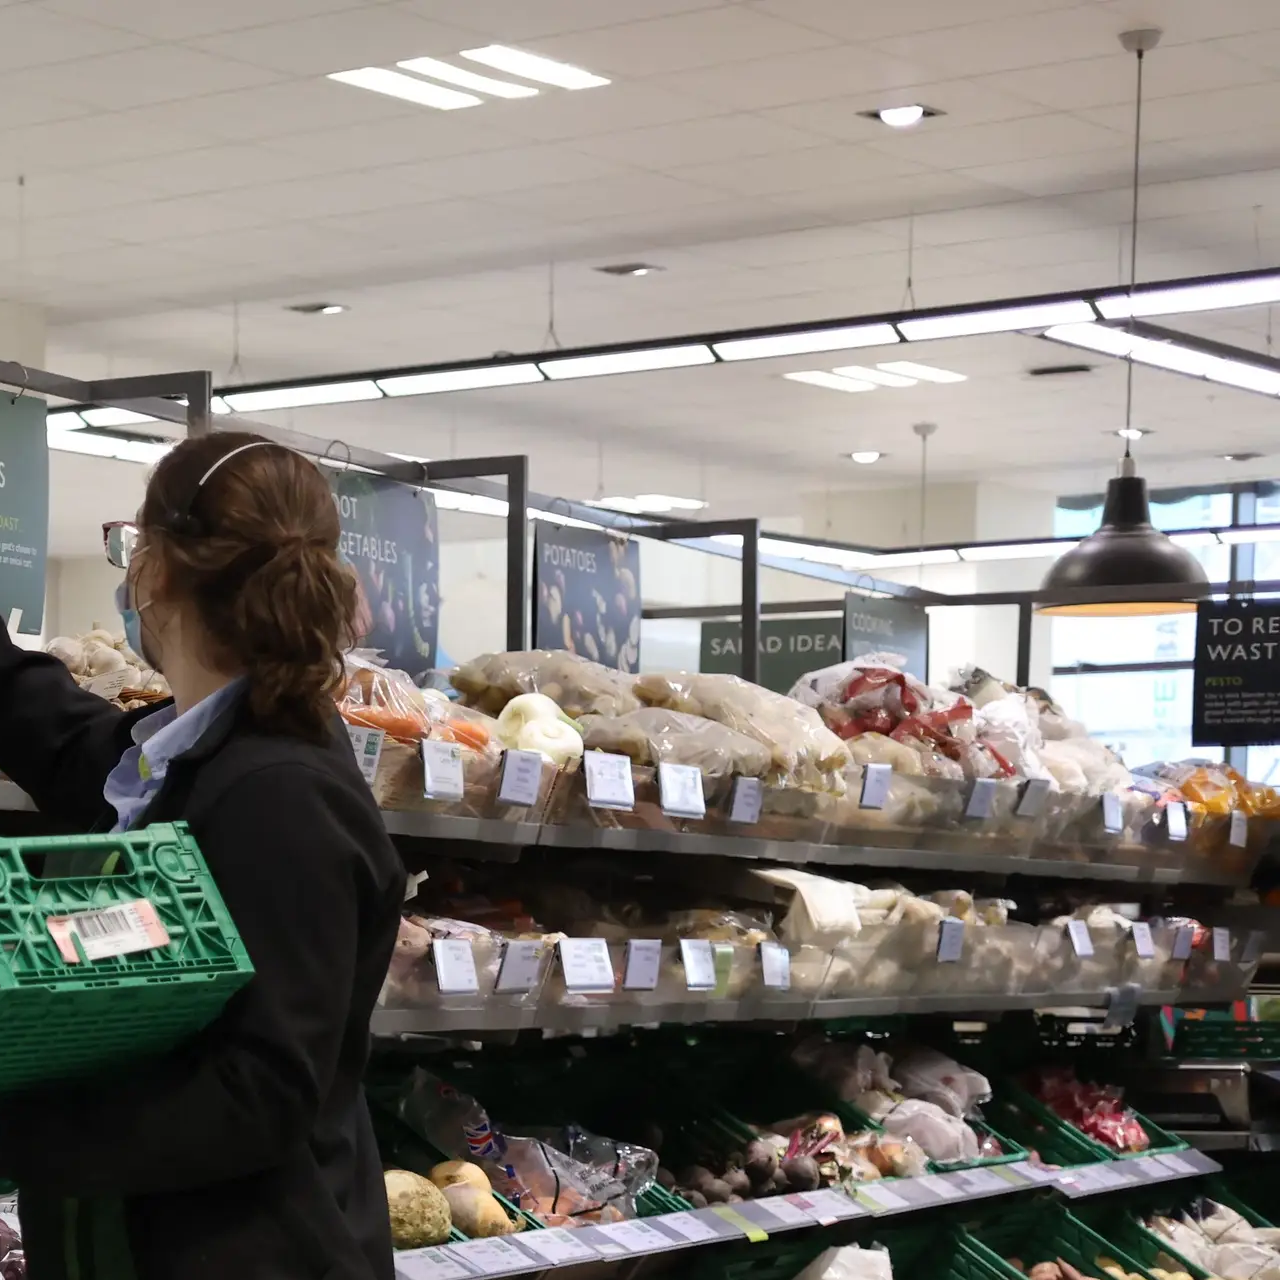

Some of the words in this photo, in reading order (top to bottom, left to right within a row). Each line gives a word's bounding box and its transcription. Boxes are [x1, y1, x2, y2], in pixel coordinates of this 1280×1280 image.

[339, 530, 398, 565] GETABLES
[544, 542, 598, 574] POTATOES
[1208, 617, 1243, 636] TO
[1204, 675, 1244, 688] PESTO
